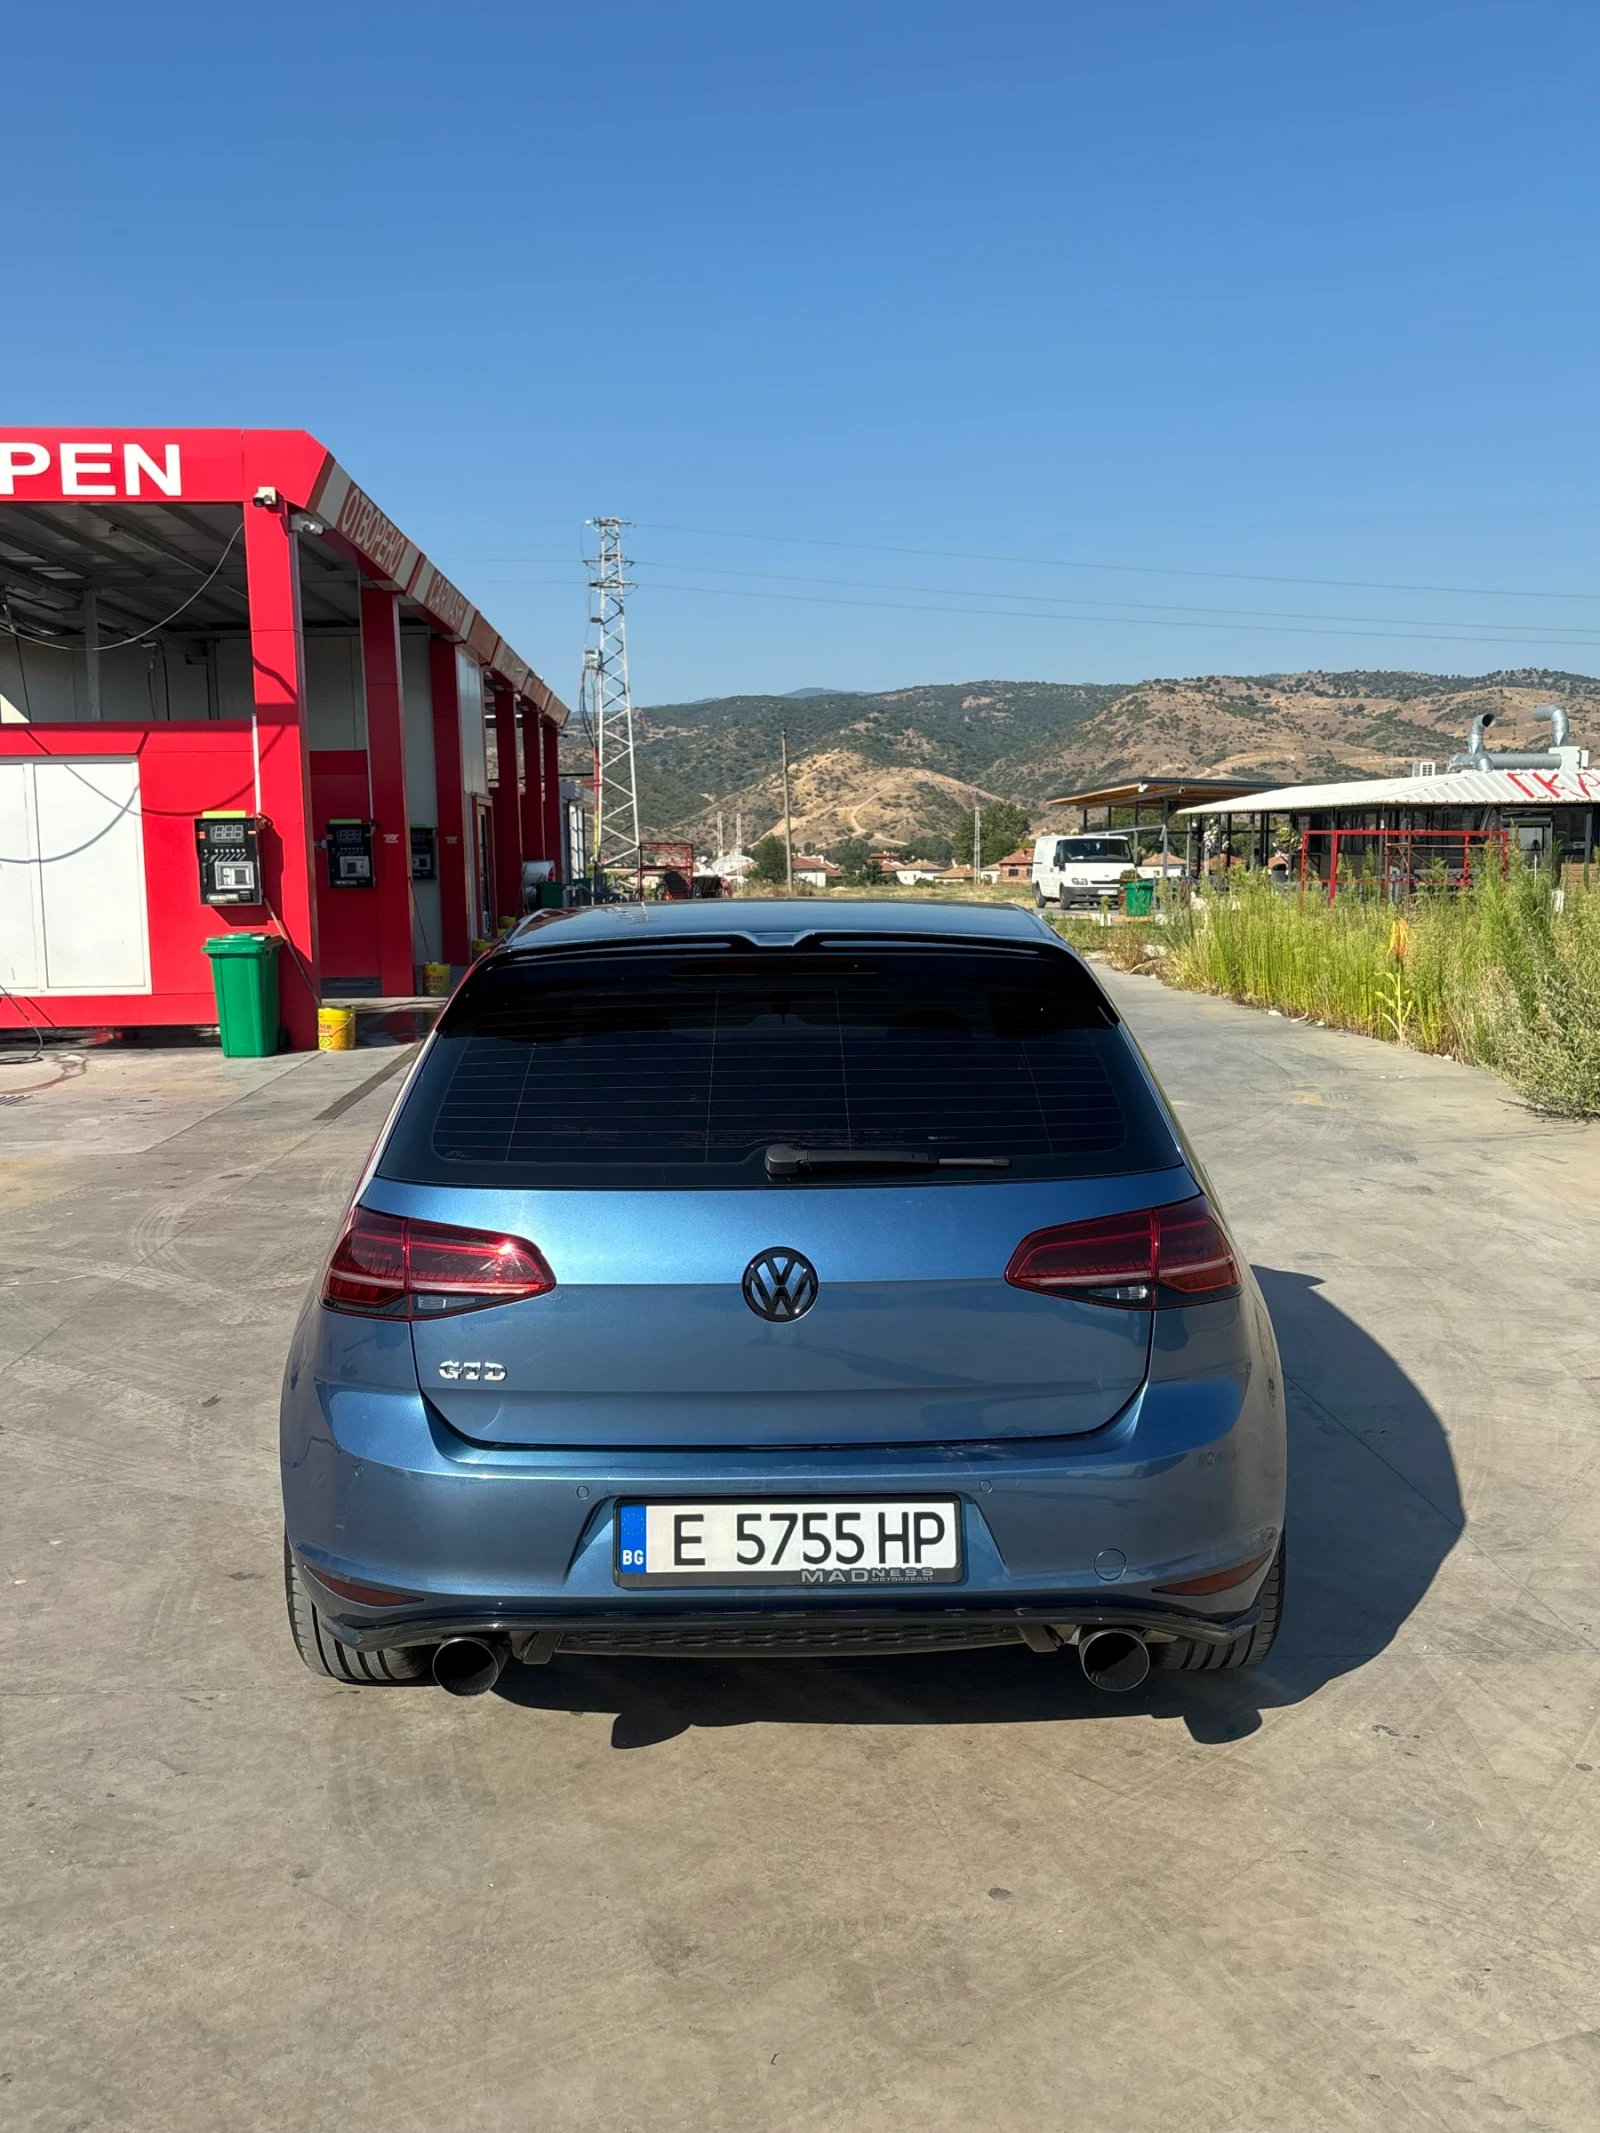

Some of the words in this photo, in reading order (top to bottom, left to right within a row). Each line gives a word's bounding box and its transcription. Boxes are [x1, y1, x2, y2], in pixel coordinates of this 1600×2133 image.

[341, 487, 405, 573] ОТВОРЕНО
[428, 574, 467, 627] CARWASH
[439, 1360, 507, 1381] GTD
[673, 1514, 706, 1566] E
[736, 1512, 865, 1566] 5755
[622, 1551, 644, 1566] BG
[801, 1568, 934, 1583] MADNESS
